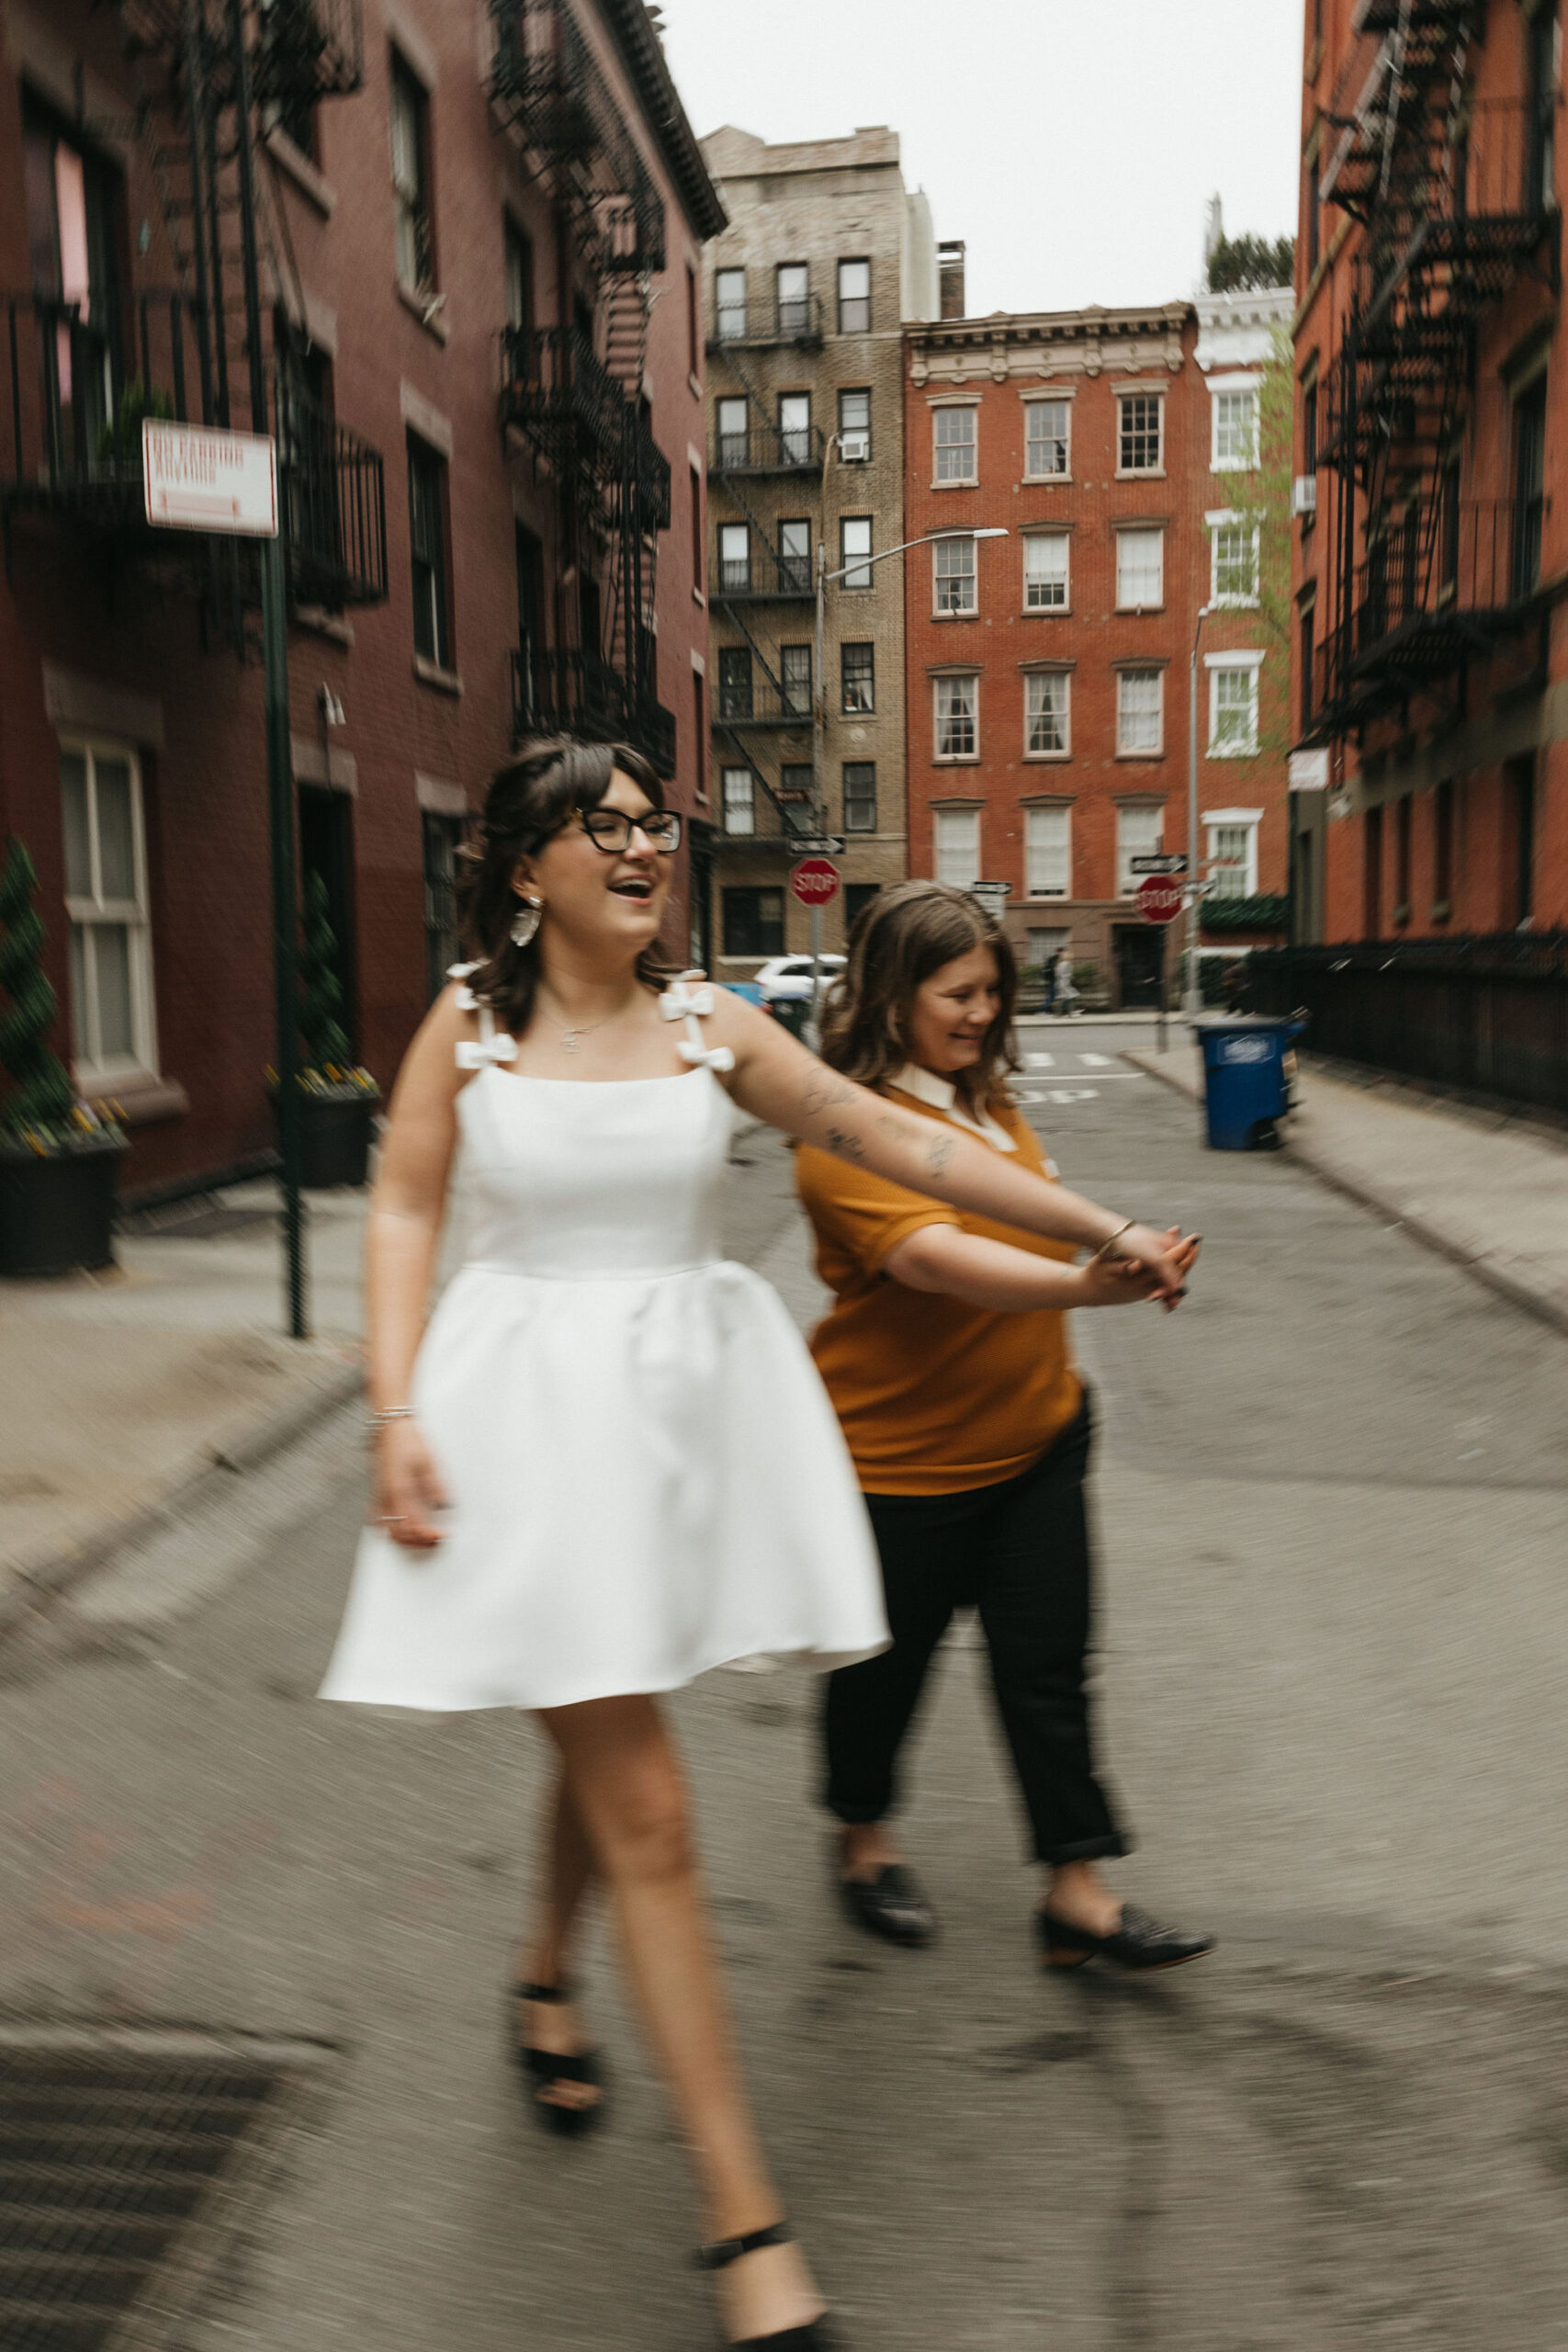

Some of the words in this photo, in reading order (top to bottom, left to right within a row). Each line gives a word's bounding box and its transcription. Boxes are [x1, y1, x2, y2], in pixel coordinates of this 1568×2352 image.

[794, 873, 837, 892] STOP
[1136, 888, 1180, 910] STOP
[1004, 1090, 1100, 1103] OP
